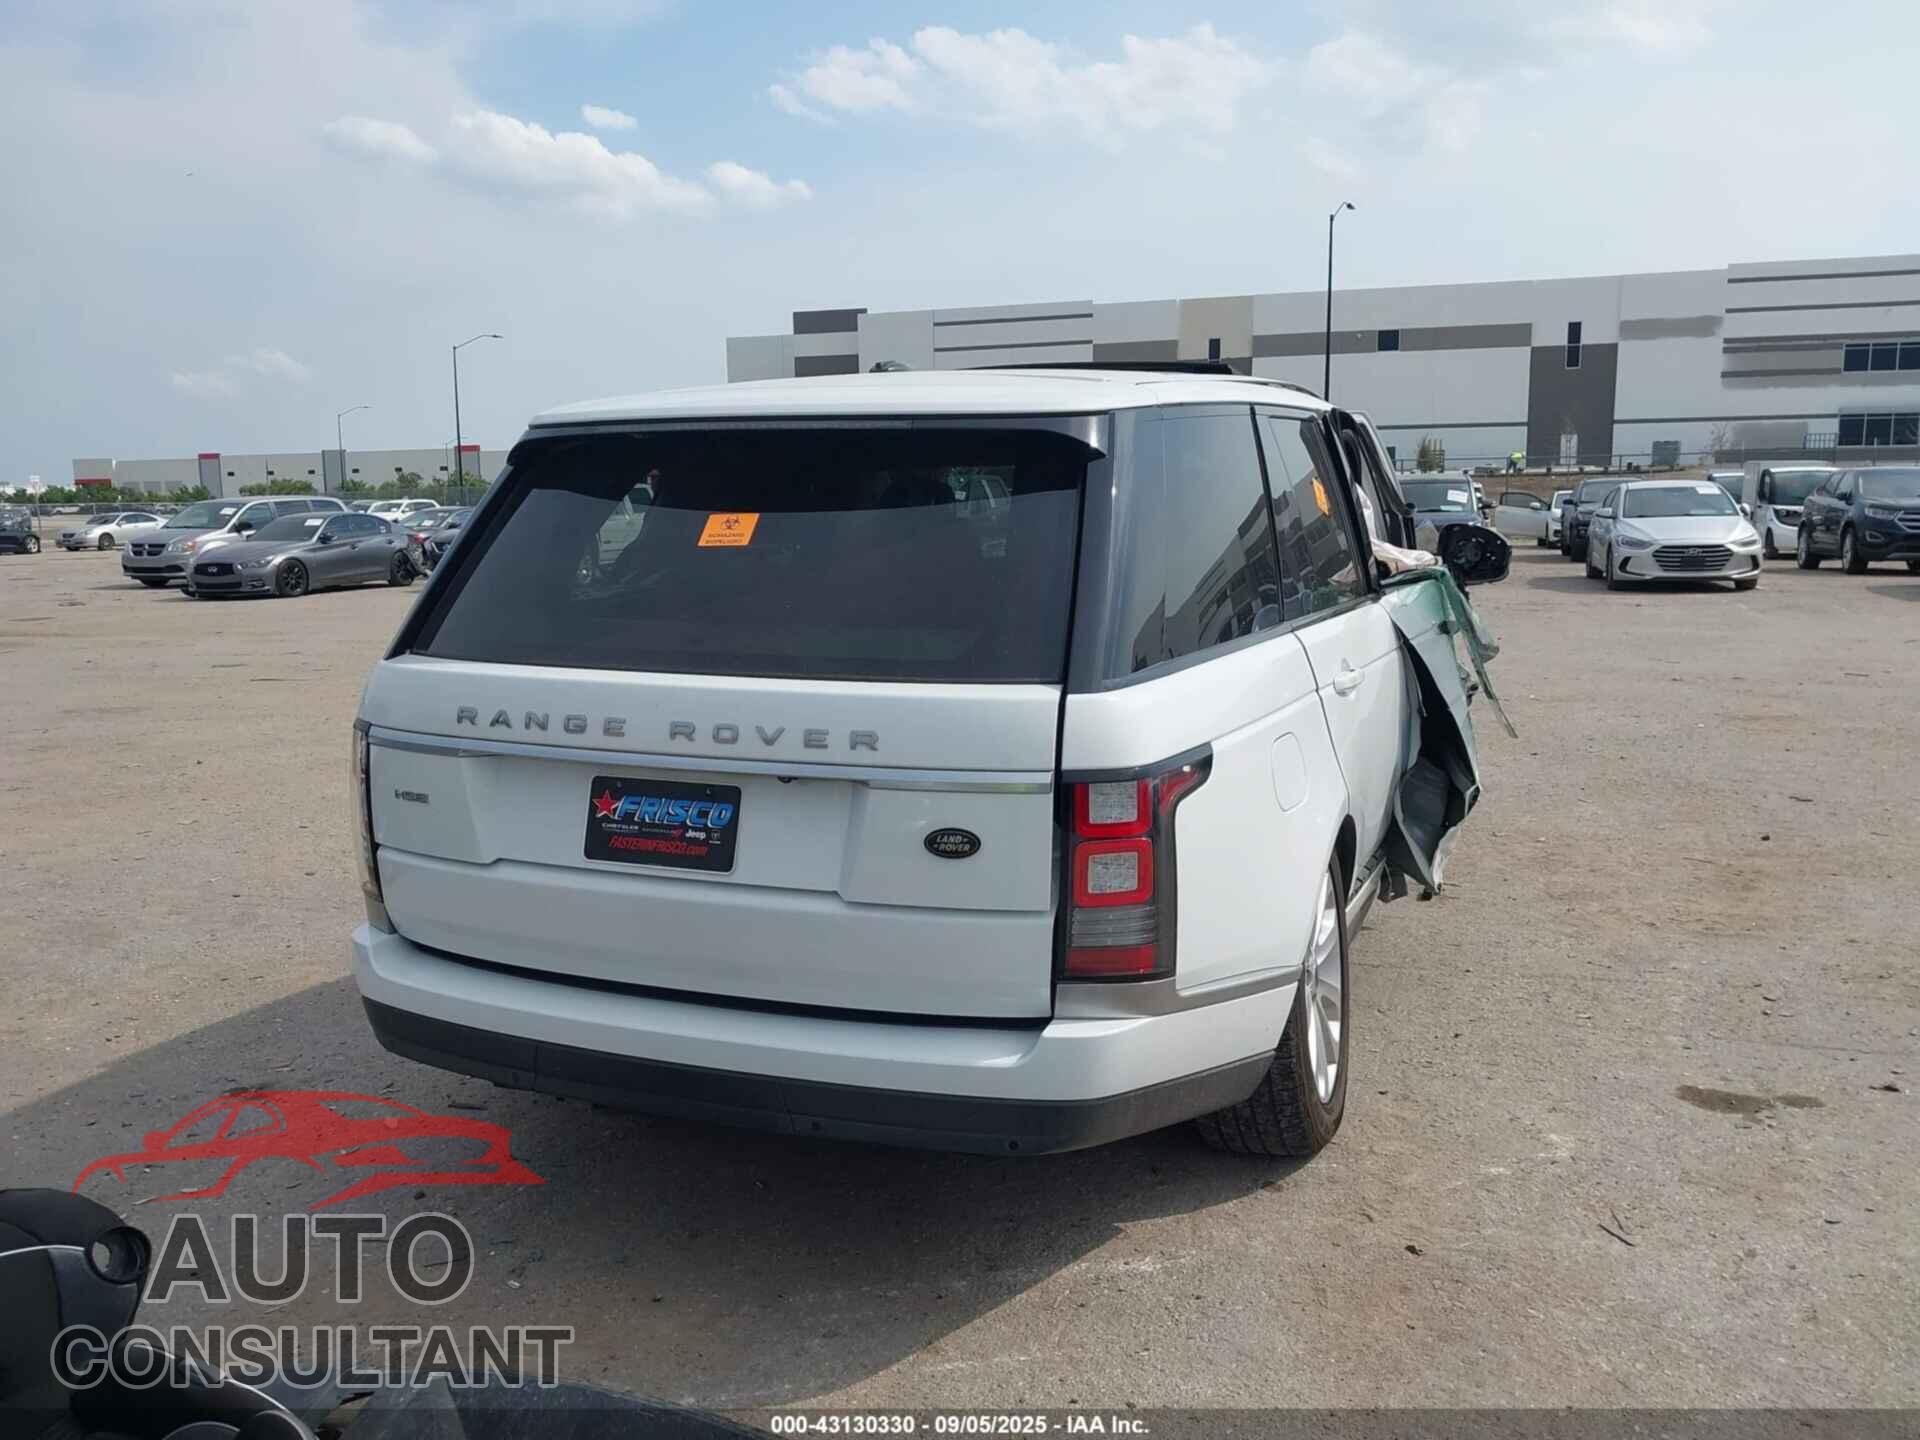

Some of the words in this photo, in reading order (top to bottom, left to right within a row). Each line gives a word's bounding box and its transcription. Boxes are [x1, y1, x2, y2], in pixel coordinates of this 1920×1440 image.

[456, 705, 626, 738] RANGE
[669, 720, 880, 752] ROVER
[614, 795, 735, 829] FRISCO
[685, 828, 707, 841] Jeep
[936, 834, 962, 843] LAND
[938, 843, 971, 852] ROVER
